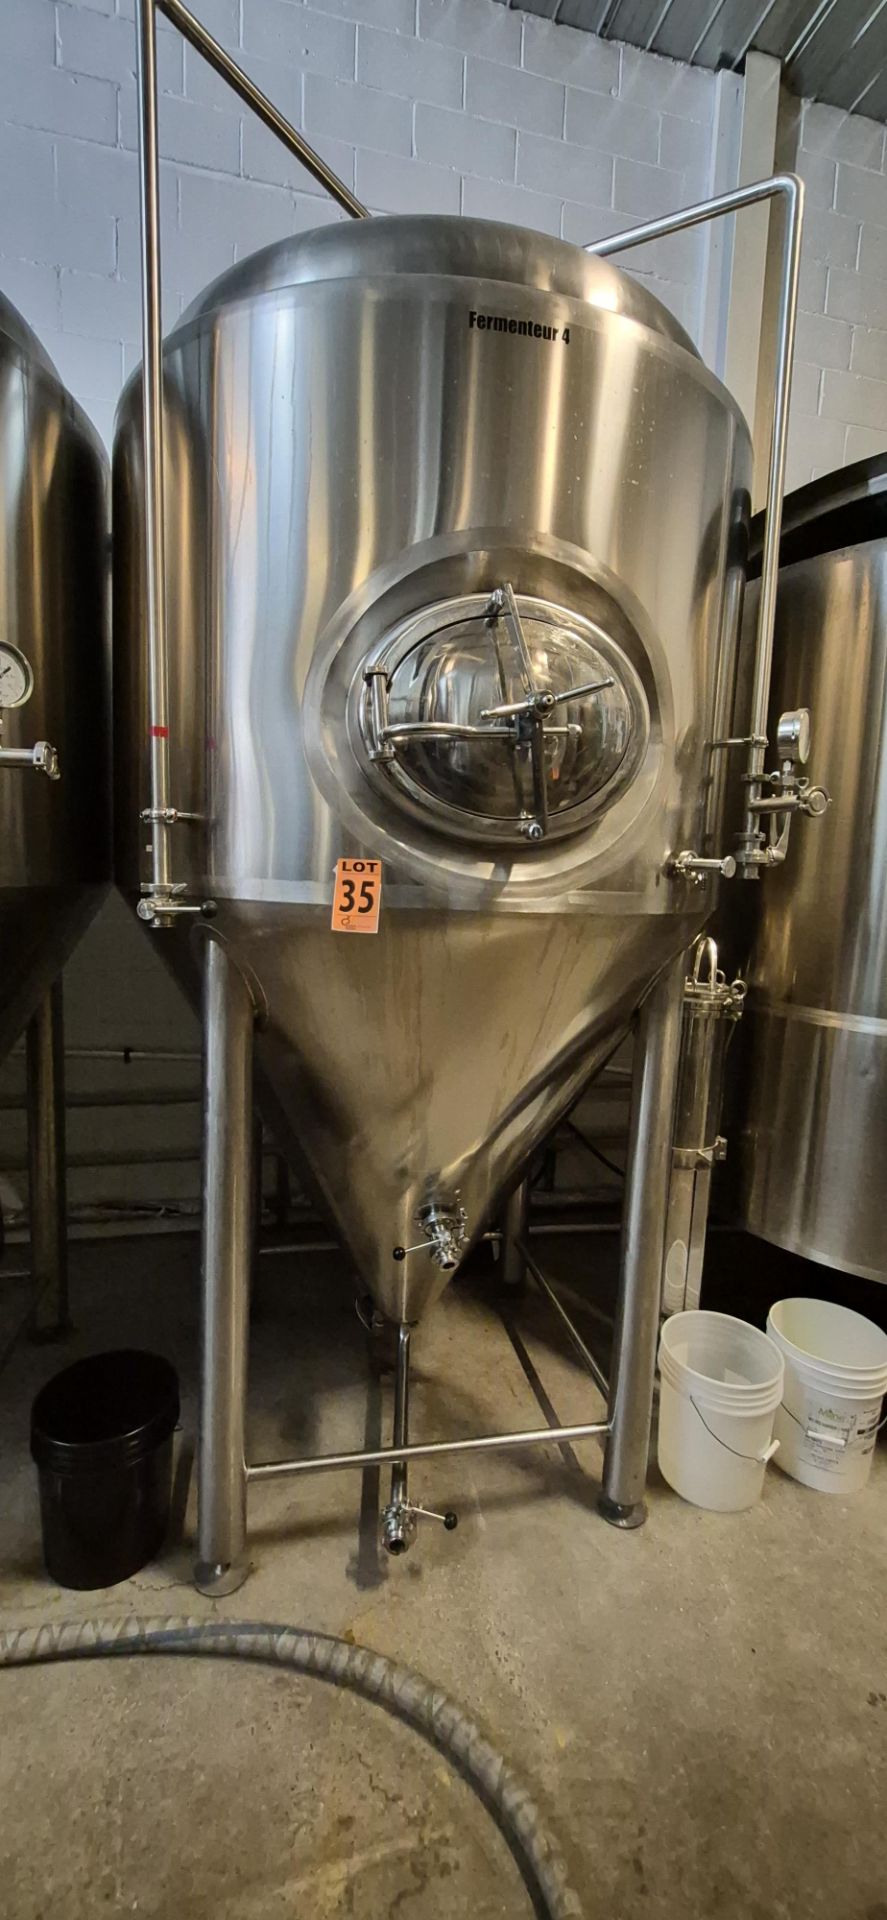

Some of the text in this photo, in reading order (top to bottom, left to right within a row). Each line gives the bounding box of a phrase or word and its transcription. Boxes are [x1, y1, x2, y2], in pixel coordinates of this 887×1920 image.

[469, 311, 570, 344] Fermenteur 4
[342, 861, 378, 873] LOT
[339, 879, 374, 913] 35
